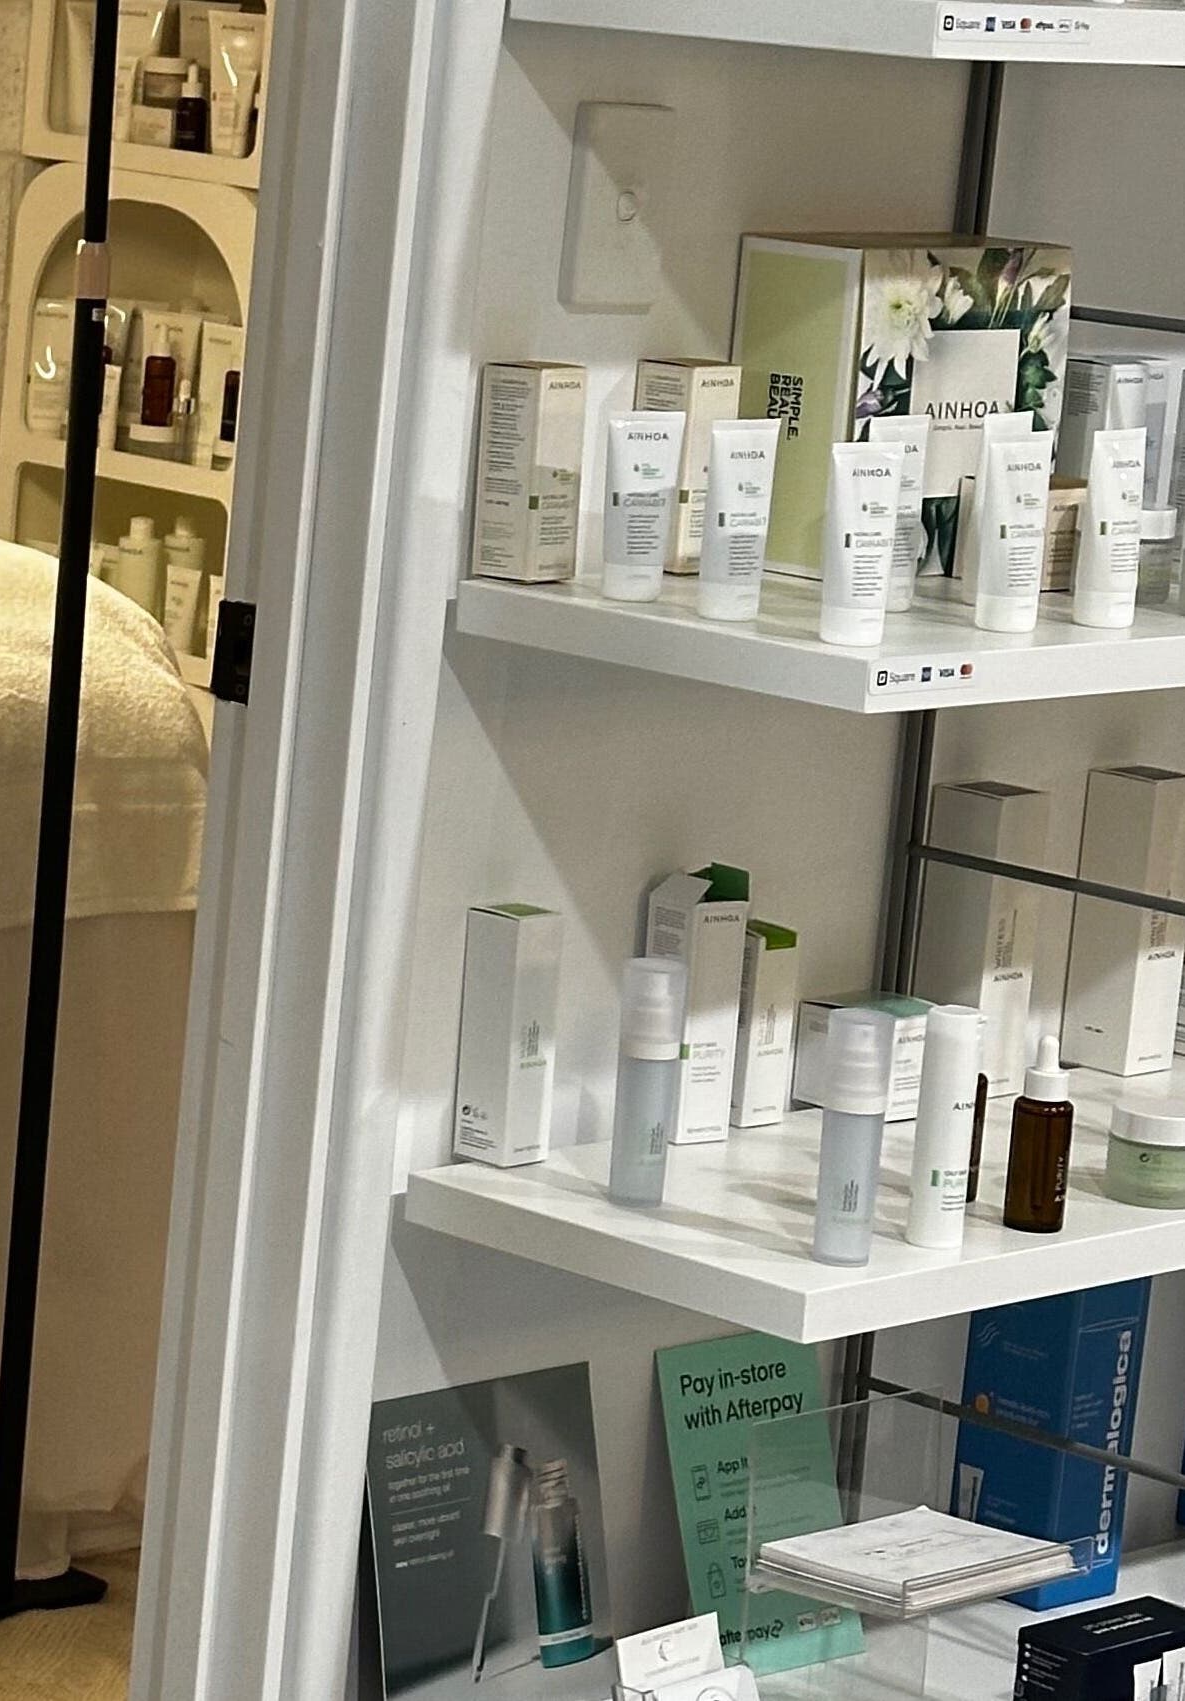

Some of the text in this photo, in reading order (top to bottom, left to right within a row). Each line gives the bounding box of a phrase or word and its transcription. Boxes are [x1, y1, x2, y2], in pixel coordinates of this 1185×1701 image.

[766, 373, 781, 419] BEAU
[786, 375, 804, 441] SIMPLE.
[924, 400, 1000, 420] AINHOA
[626, 432, 670, 441] AINHOA
[729, 450, 766, 460] AINHOA
[851, 468, 892, 477] AINHOA
[1006, 462, 1042, 472] AINHOA
[680, 1361, 787, 1397] Pay in-store
[684, 1392, 804, 1430] with Afterpay
[382, 1420, 423, 1443] retinol
[1095, 1329, 1132, 1556] dermalogica
[385, 1437, 465, 1469] salicylic acid
[716, 1460, 740, 1475] App
[719, 1623, 771, 1647] aftepay
